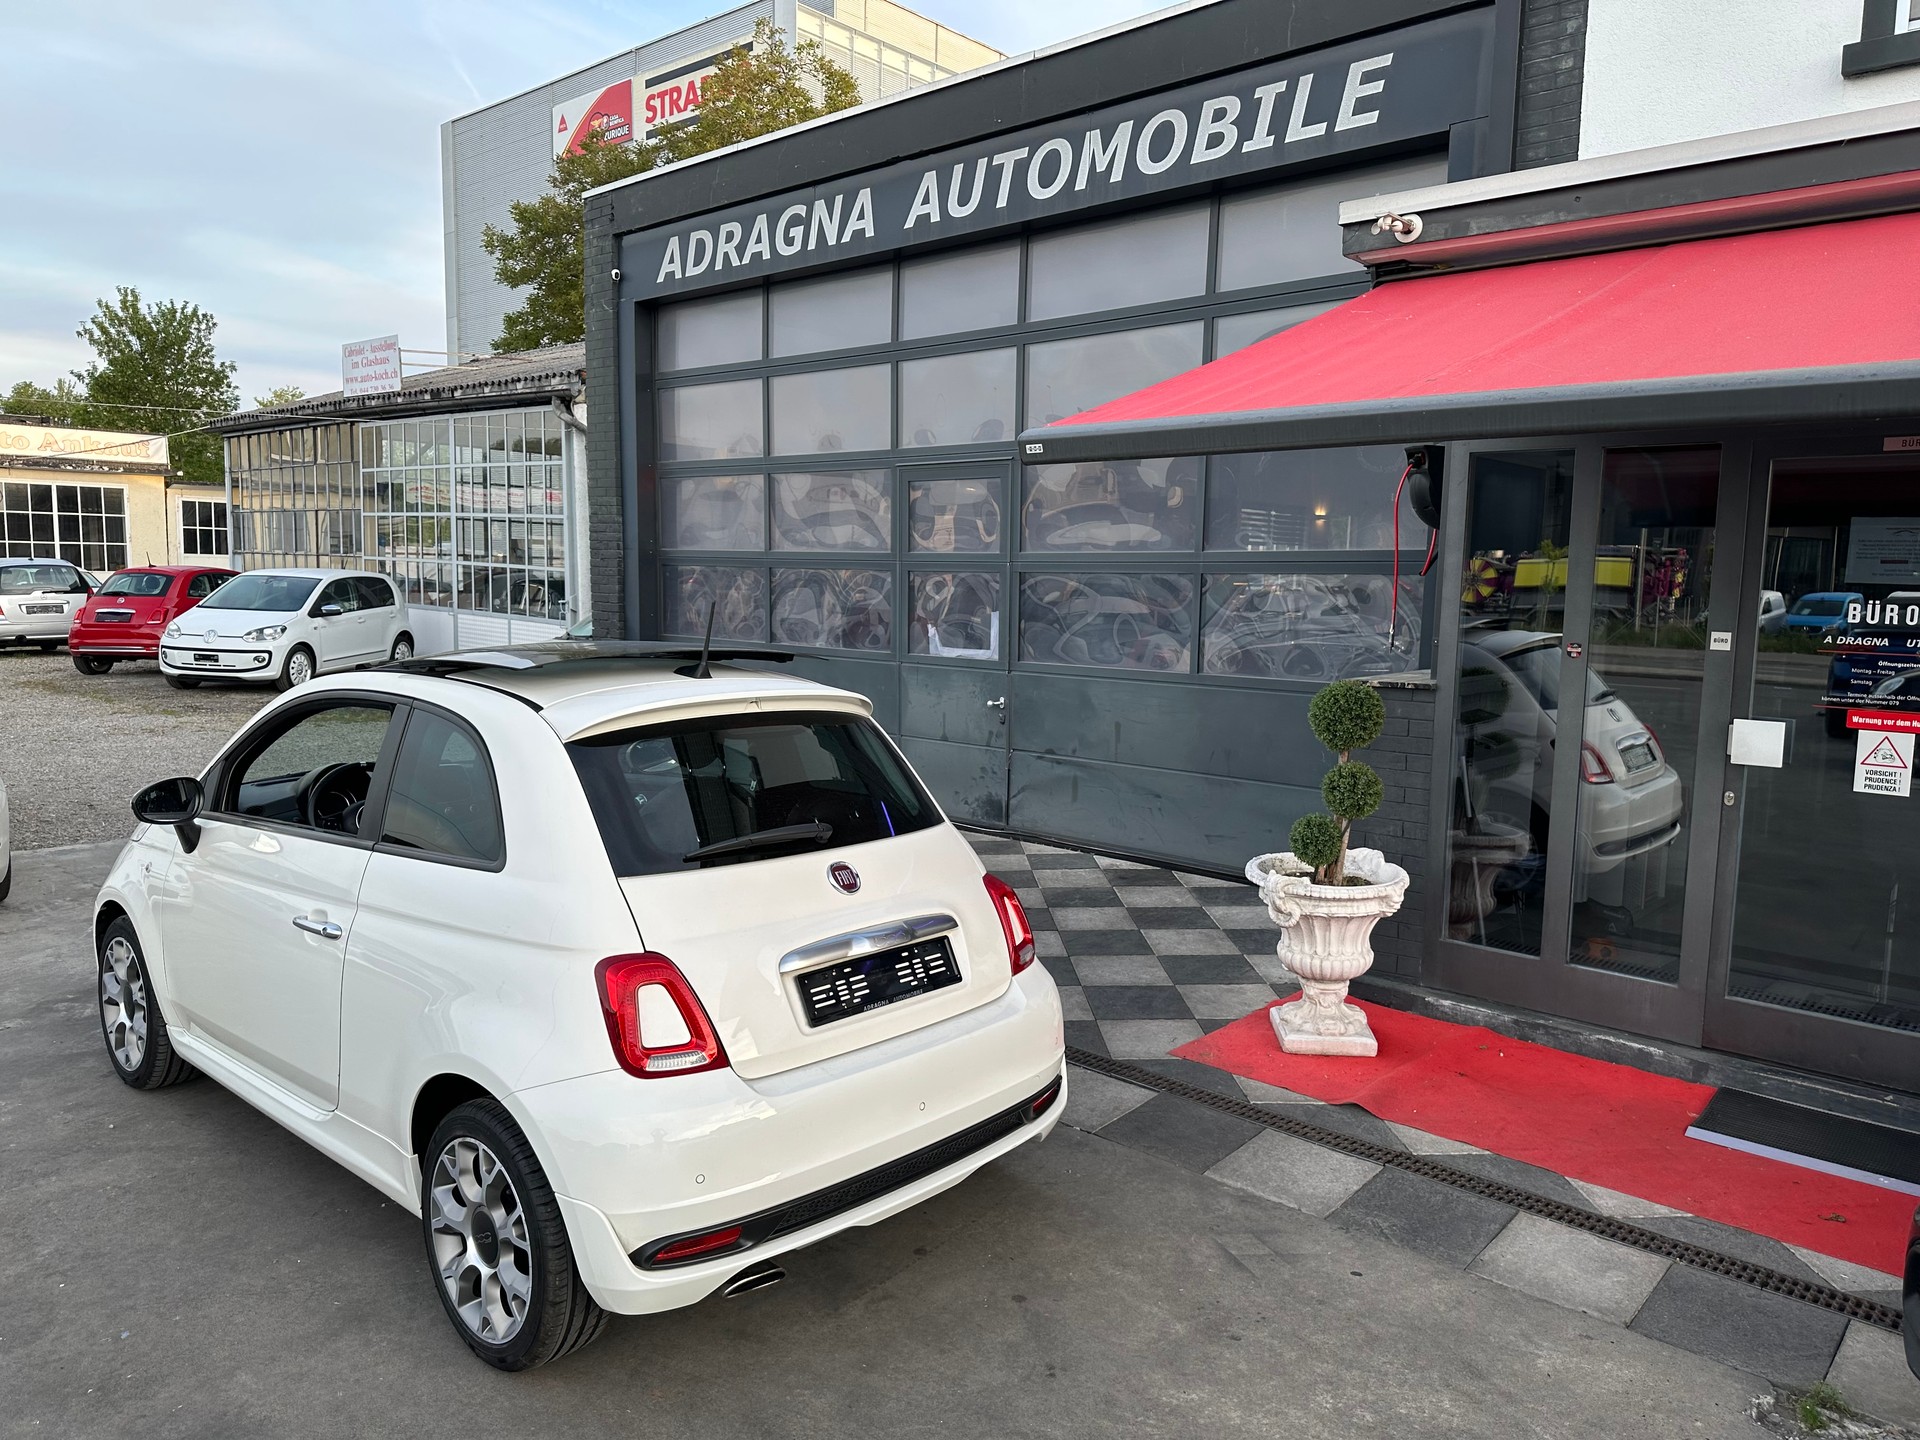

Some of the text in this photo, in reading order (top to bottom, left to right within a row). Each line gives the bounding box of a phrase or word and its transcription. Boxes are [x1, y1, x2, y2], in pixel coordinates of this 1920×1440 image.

[656, 52, 1395, 284] ADRAGNA AUTOMOBILE
[351, 355, 390, 370] im Glashaus
[345, 368, 398, 384] www.auto-koch.ch
[37, 432, 150, 459] Ankauf
[1848, 600, 1920, 625] BÜRO
[1852, 716, 1883, 726] Warnung
[1896, 719, 1911, 727] dem
[1864, 776, 1897, 785] PRUDENCE
[1865, 769, 1898, 778] VORSICHT
[1863, 783, 1897, 793] PRUDENZA
[835, 869, 855, 886] FIAT
[863, 1000, 890, 1012] ADRAGNA
